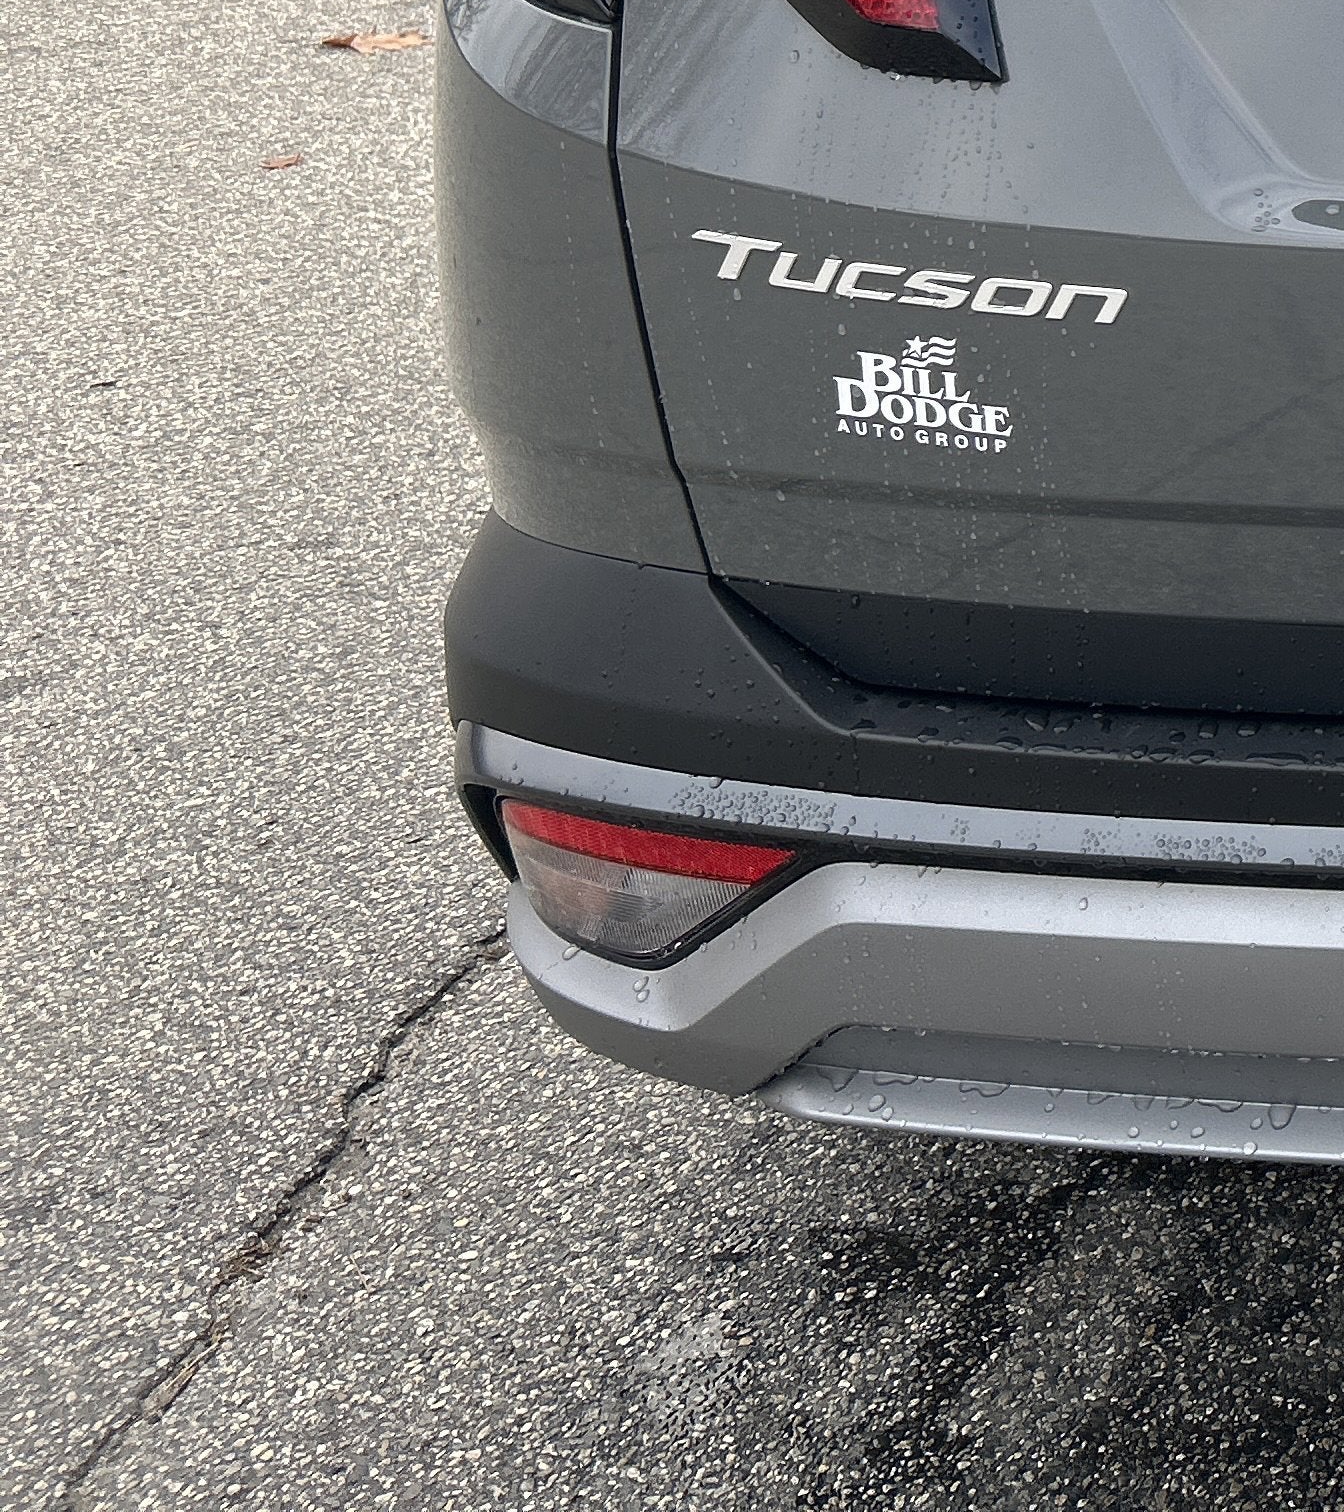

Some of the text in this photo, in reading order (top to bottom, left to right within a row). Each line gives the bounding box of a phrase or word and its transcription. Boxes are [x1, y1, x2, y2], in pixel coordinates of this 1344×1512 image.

[856, 350, 971, 403] BILL
[832, 376, 1014, 438] DODGE
[837, 418, 1008, 453] AUTO GROUP
